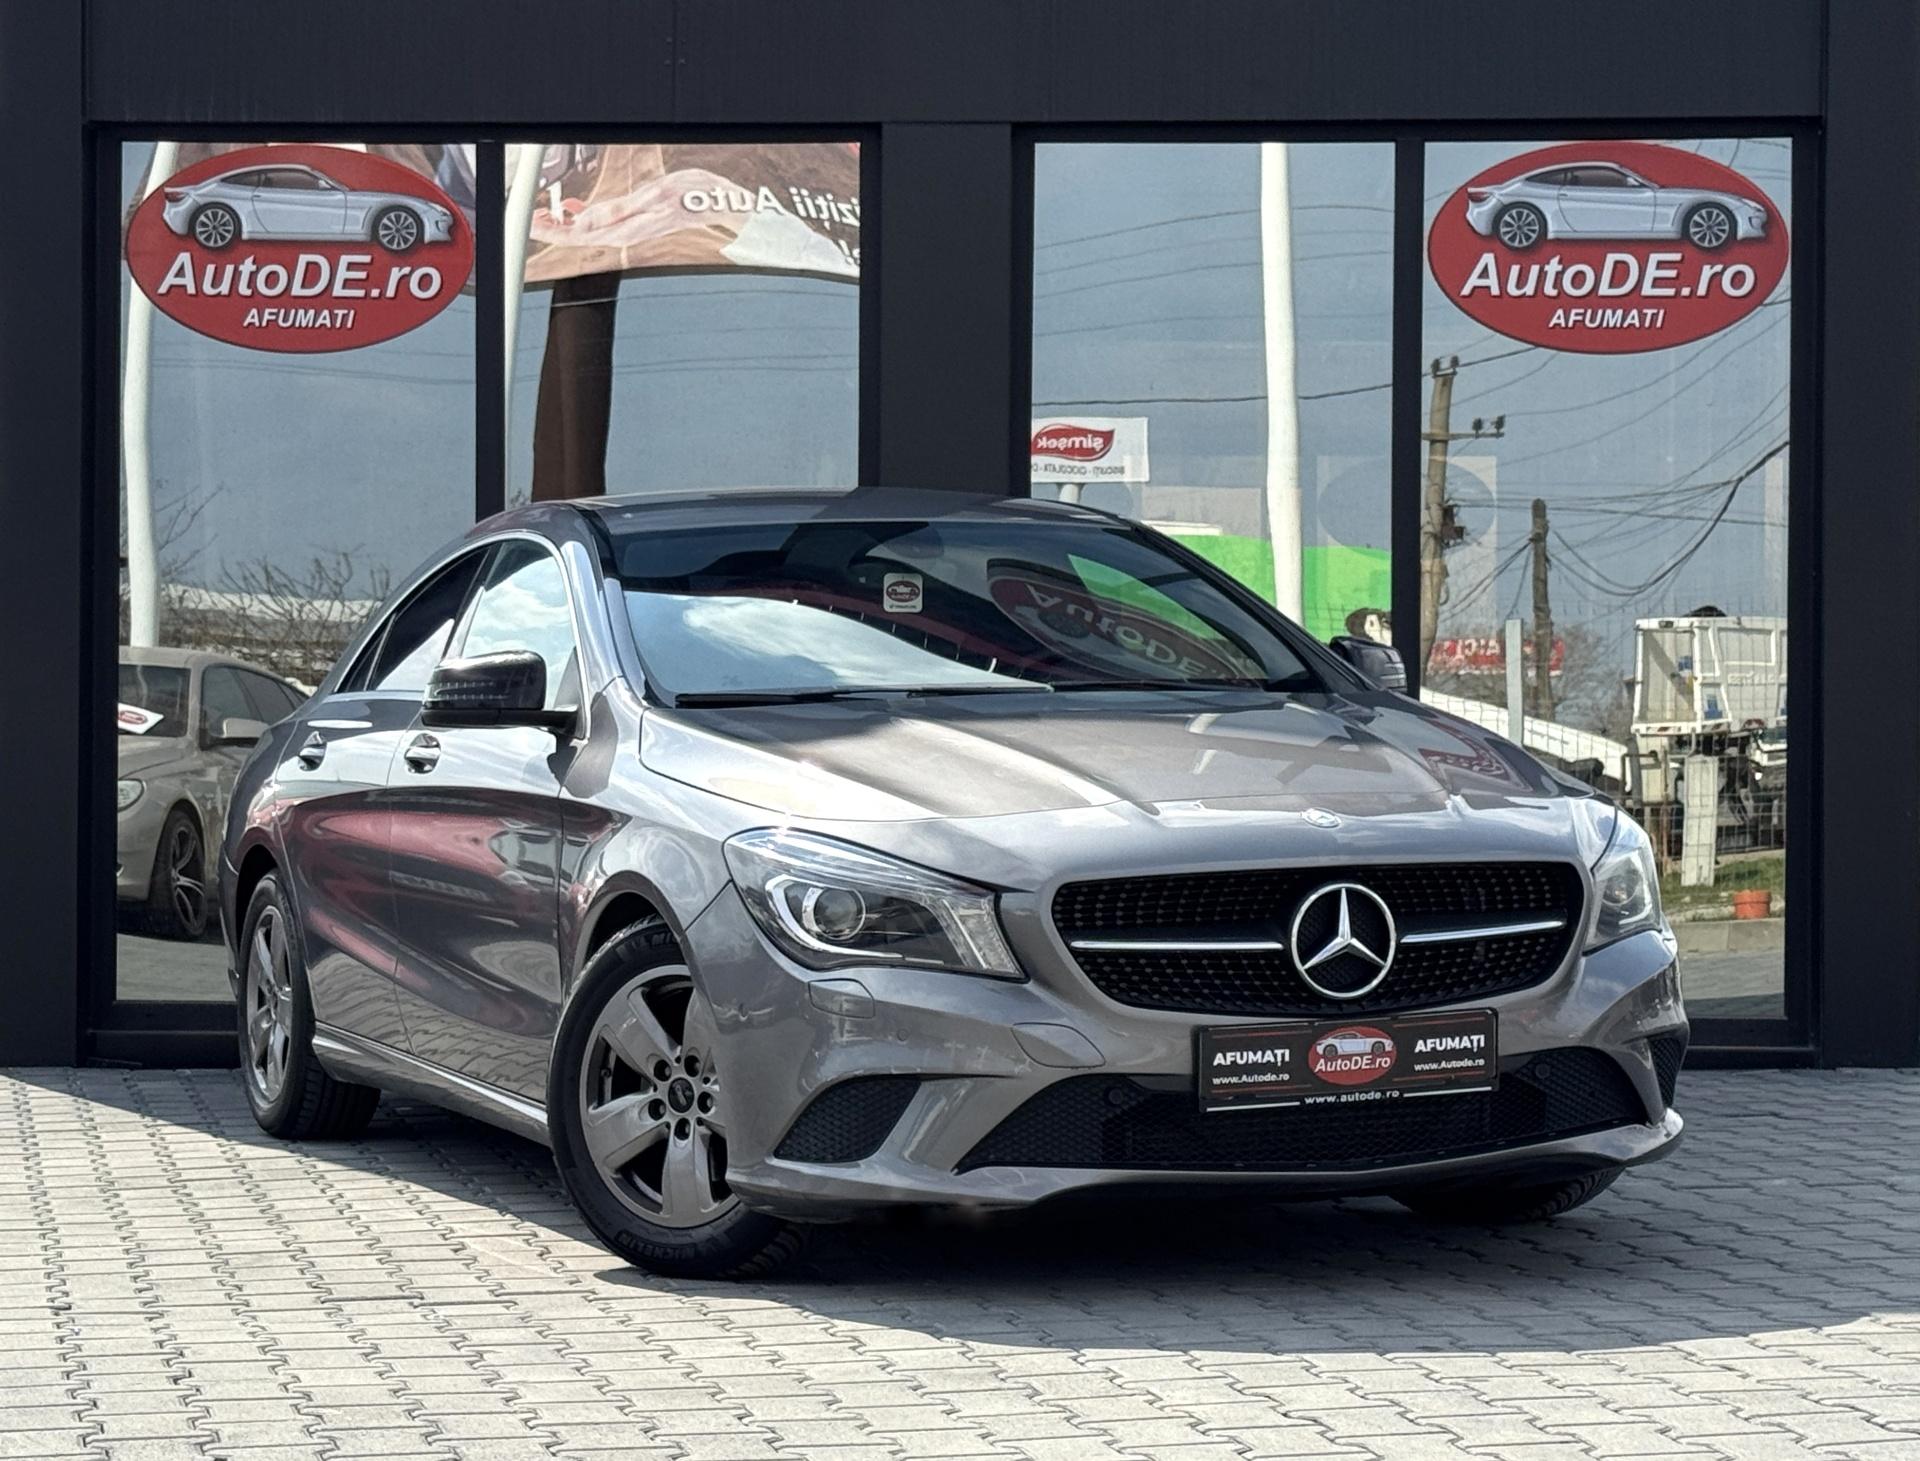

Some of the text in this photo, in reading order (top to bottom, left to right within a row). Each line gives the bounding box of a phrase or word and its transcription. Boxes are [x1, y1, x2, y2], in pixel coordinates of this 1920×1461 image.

[156, 251, 444, 300] AutoDE.ro
[1459, 252, 1756, 299] AutoDE.ro
[242, 308, 356, 329] AFUMATI
[1548, 308, 1666, 329] AFUMATI
[1414, 1034, 1485, 1053] AFUMAȚI
[1213, 1048, 1290, 1067] AFUMAȚI
[1314, 1054, 1391, 1073] AutoDE.ro
[1413, 1058, 1485, 1071] www.Autode.ro
[1212, 1072, 1290, 1085] www.Autode.ro
[1304, 1089, 1400, 1104] www.autode.ro
